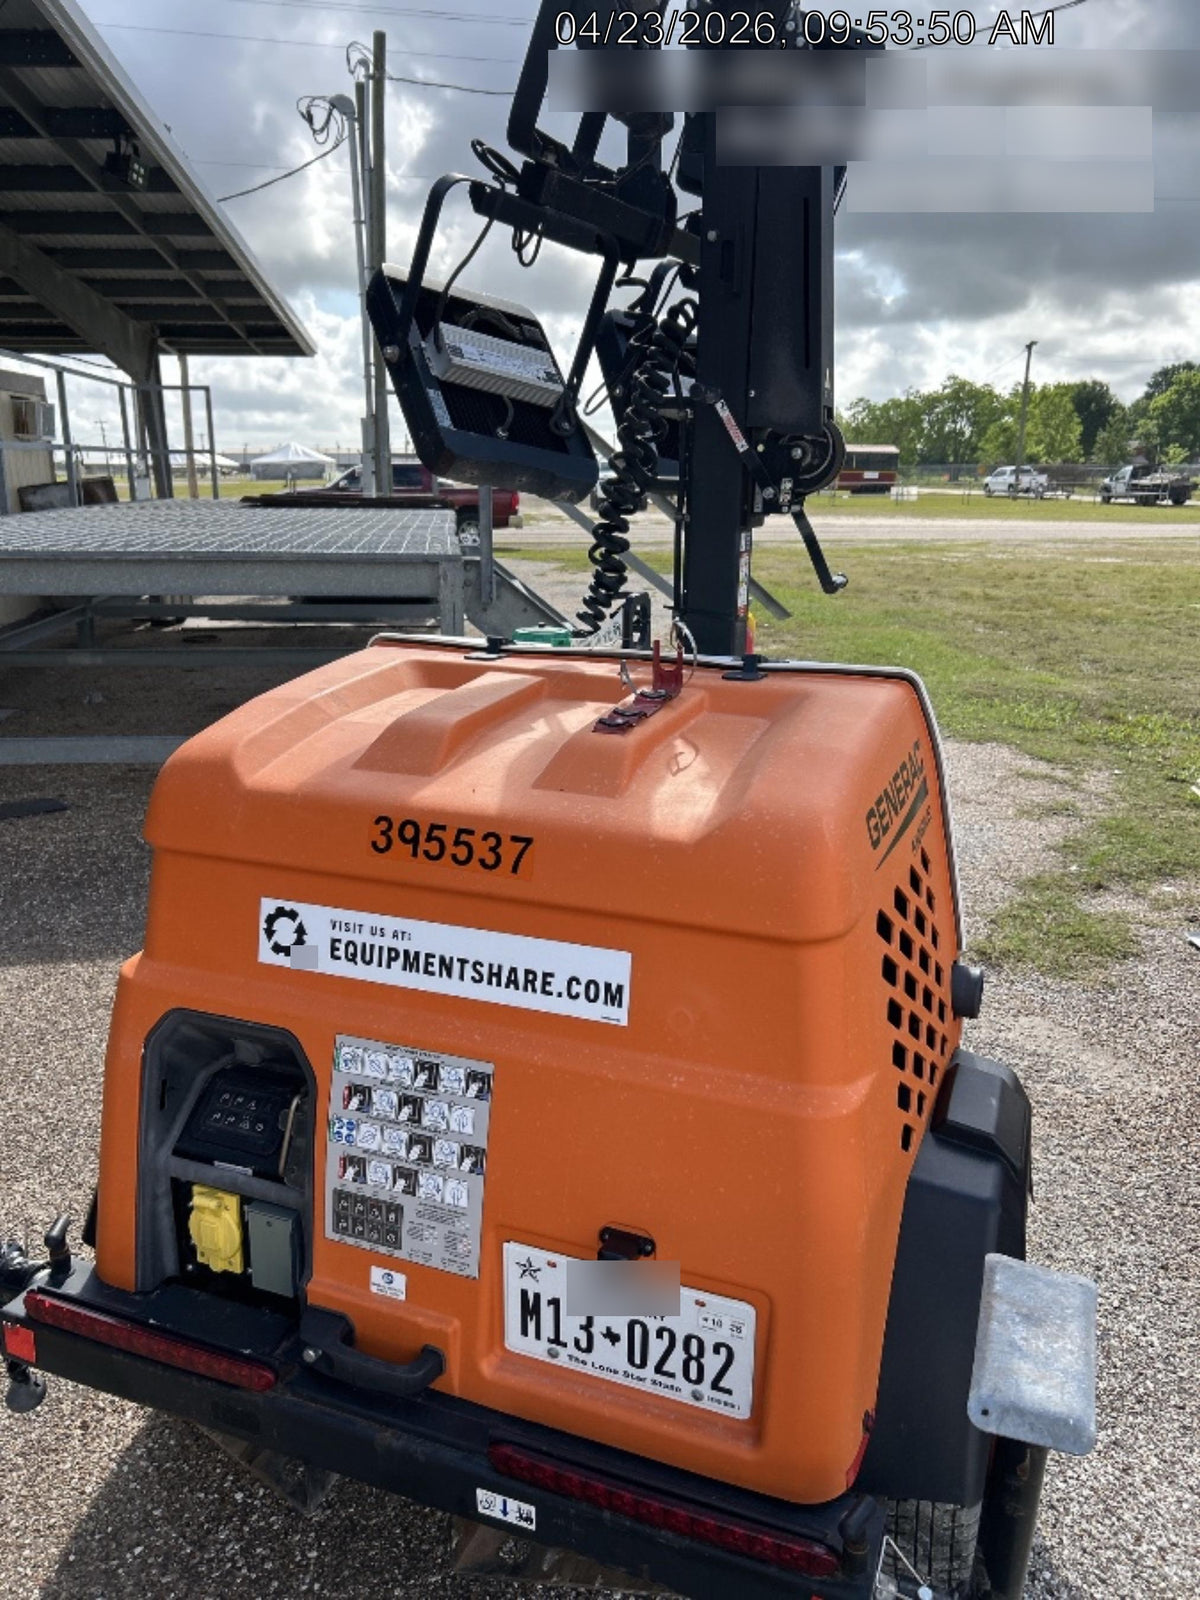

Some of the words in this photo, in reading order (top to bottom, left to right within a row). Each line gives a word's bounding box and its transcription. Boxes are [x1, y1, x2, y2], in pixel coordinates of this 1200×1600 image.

[866, 739, 924, 850] GENERAC
[371, 815, 533, 874] 395537
[330, 918, 363, 934] VISIT
[370, 926, 385, 937] US
[392, 930, 412, 941] AT:
[330, 938, 624, 1008] EQUIPMENTSHARE.COM
[567, 1354, 588, 1366] The
[591, 1361, 619, 1375] Lone
[623, 1370, 647, 1384] Star
